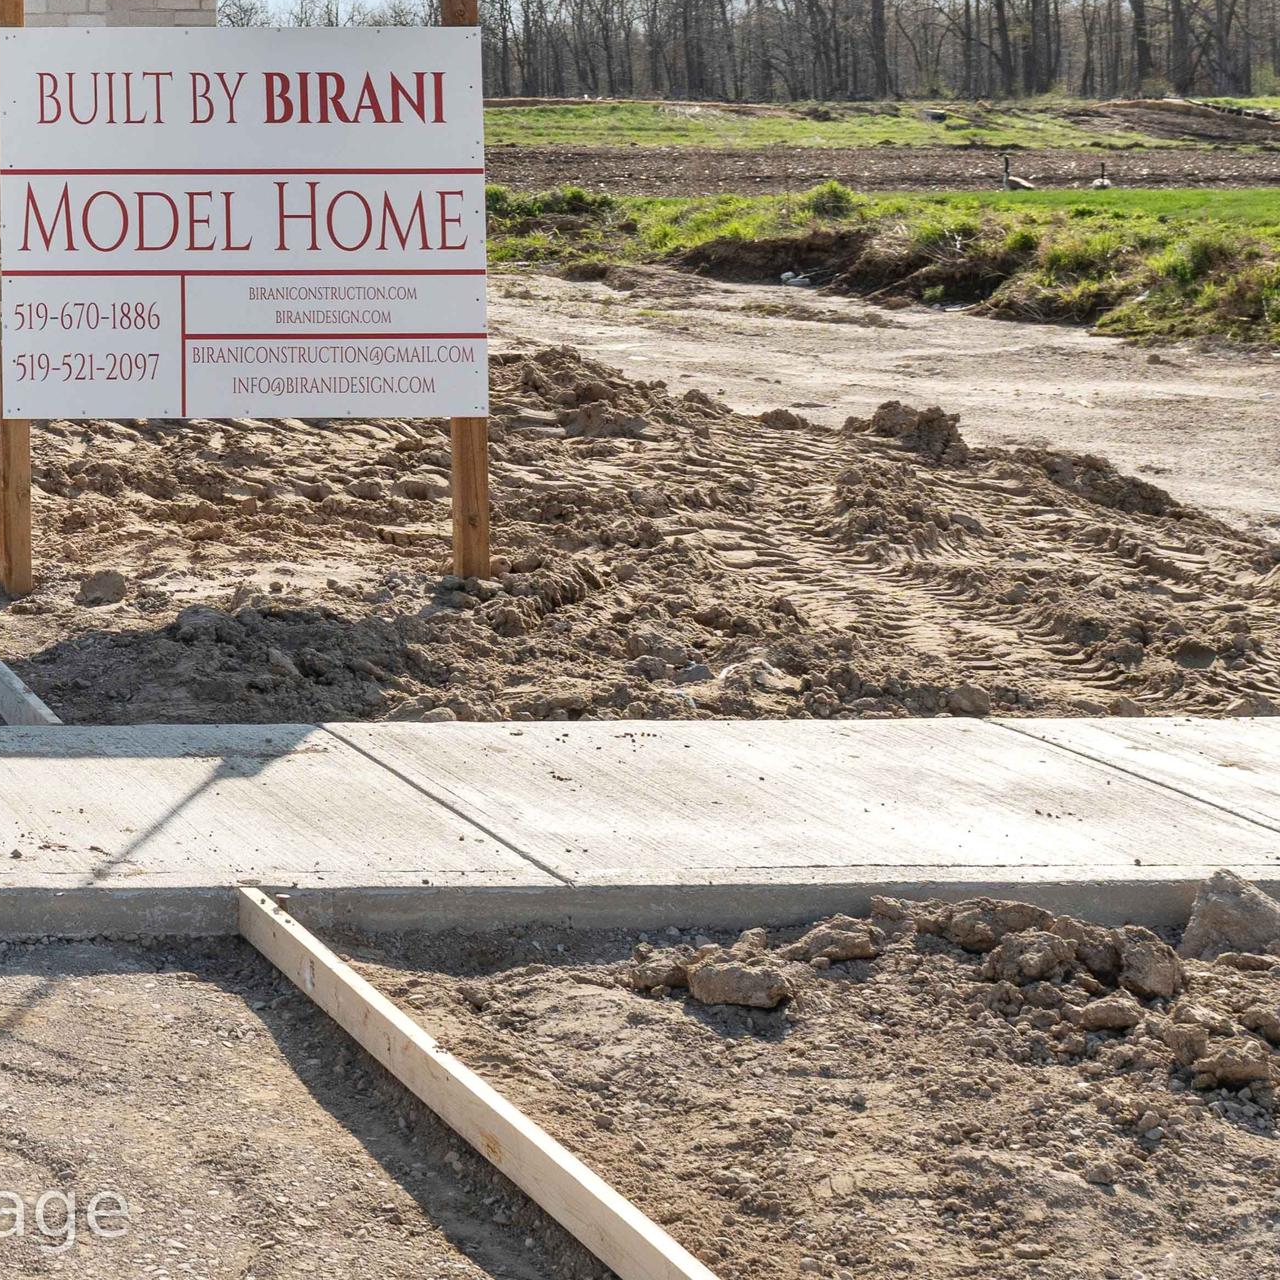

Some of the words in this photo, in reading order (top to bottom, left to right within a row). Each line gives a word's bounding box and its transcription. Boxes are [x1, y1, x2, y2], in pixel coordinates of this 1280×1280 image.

[35, 71, 173, 125] BUILT
[188, 71, 249, 124] BY
[262, 71, 447, 124] BIRANI
[248, 286, 418, 301] BIRANICONSTRUCTION.COM
[14, 301, 161, 331] 519-670-1886
[275, 309, 392, 324] BIRANIDESIGN.COM
[191, 345, 475, 365] BIRANICONSTRUCTION@GMAIL.COM
[16, 352, 160, 382] 519-521-2097
[232, 376, 436, 396] INFO@BIRANIDESIGN.COM
